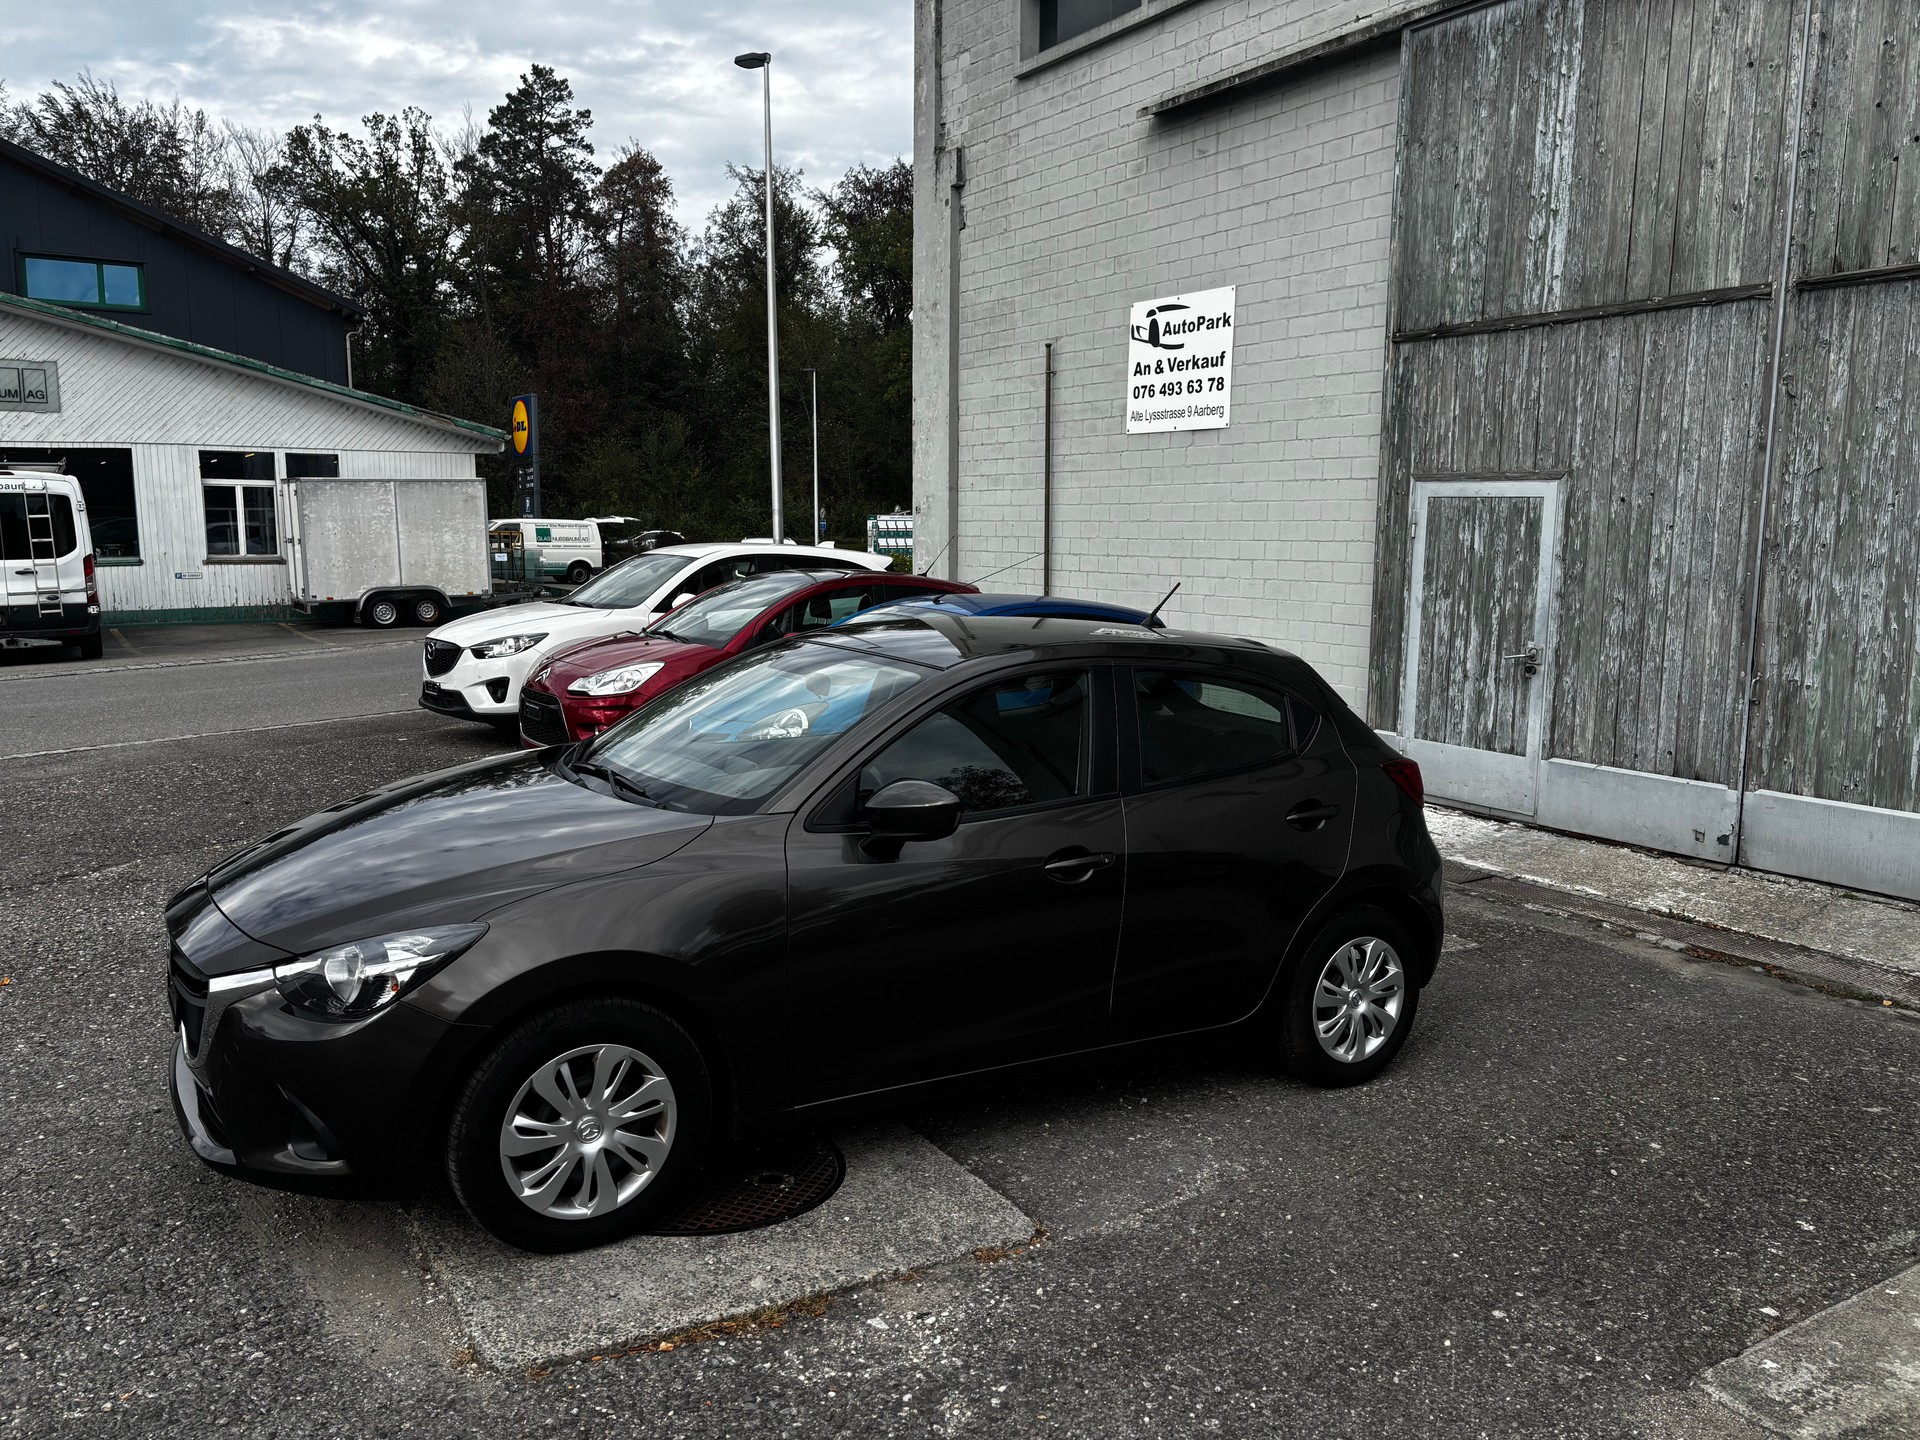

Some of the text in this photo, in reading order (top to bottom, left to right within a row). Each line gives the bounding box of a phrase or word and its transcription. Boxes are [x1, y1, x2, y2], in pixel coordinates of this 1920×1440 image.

[1162, 312, 1231, 336] AutoPark
[1133, 351, 1226, 377] An & Verkauf
[26, 389, 45, 400] AG
[1133, 376, 1225, 400] 076 493 63 78
[1130, 404, 1225, 424] Alte Lyssstrasse 9 Aarberg
